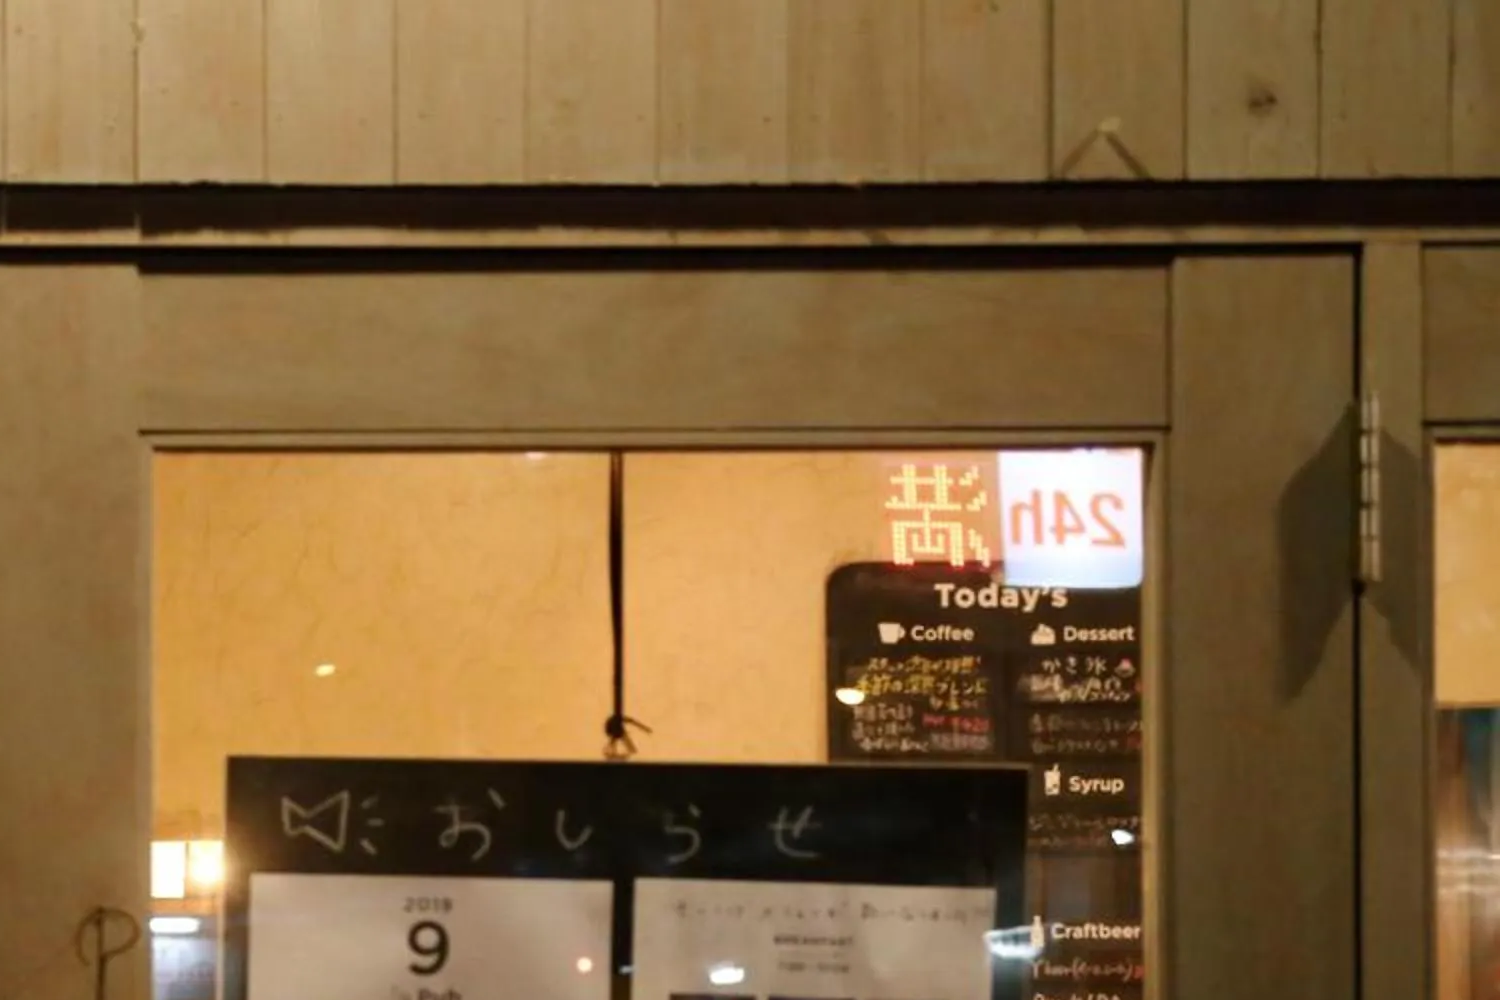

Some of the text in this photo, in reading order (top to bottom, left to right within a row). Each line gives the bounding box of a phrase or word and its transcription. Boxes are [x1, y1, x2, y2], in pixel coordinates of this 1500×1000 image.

[935, 583, 1068, 612] Today's
[911, 625, 975, 641] Coffee
[1063, 625, 1135, 641] Dessert
[1069, 776, 1125, 793] Syrup
[432, 787, 822, 862] おしらせ
[1051, 922, 1141, 939] Craftbeer
[407, 920, 450, 977] 9
